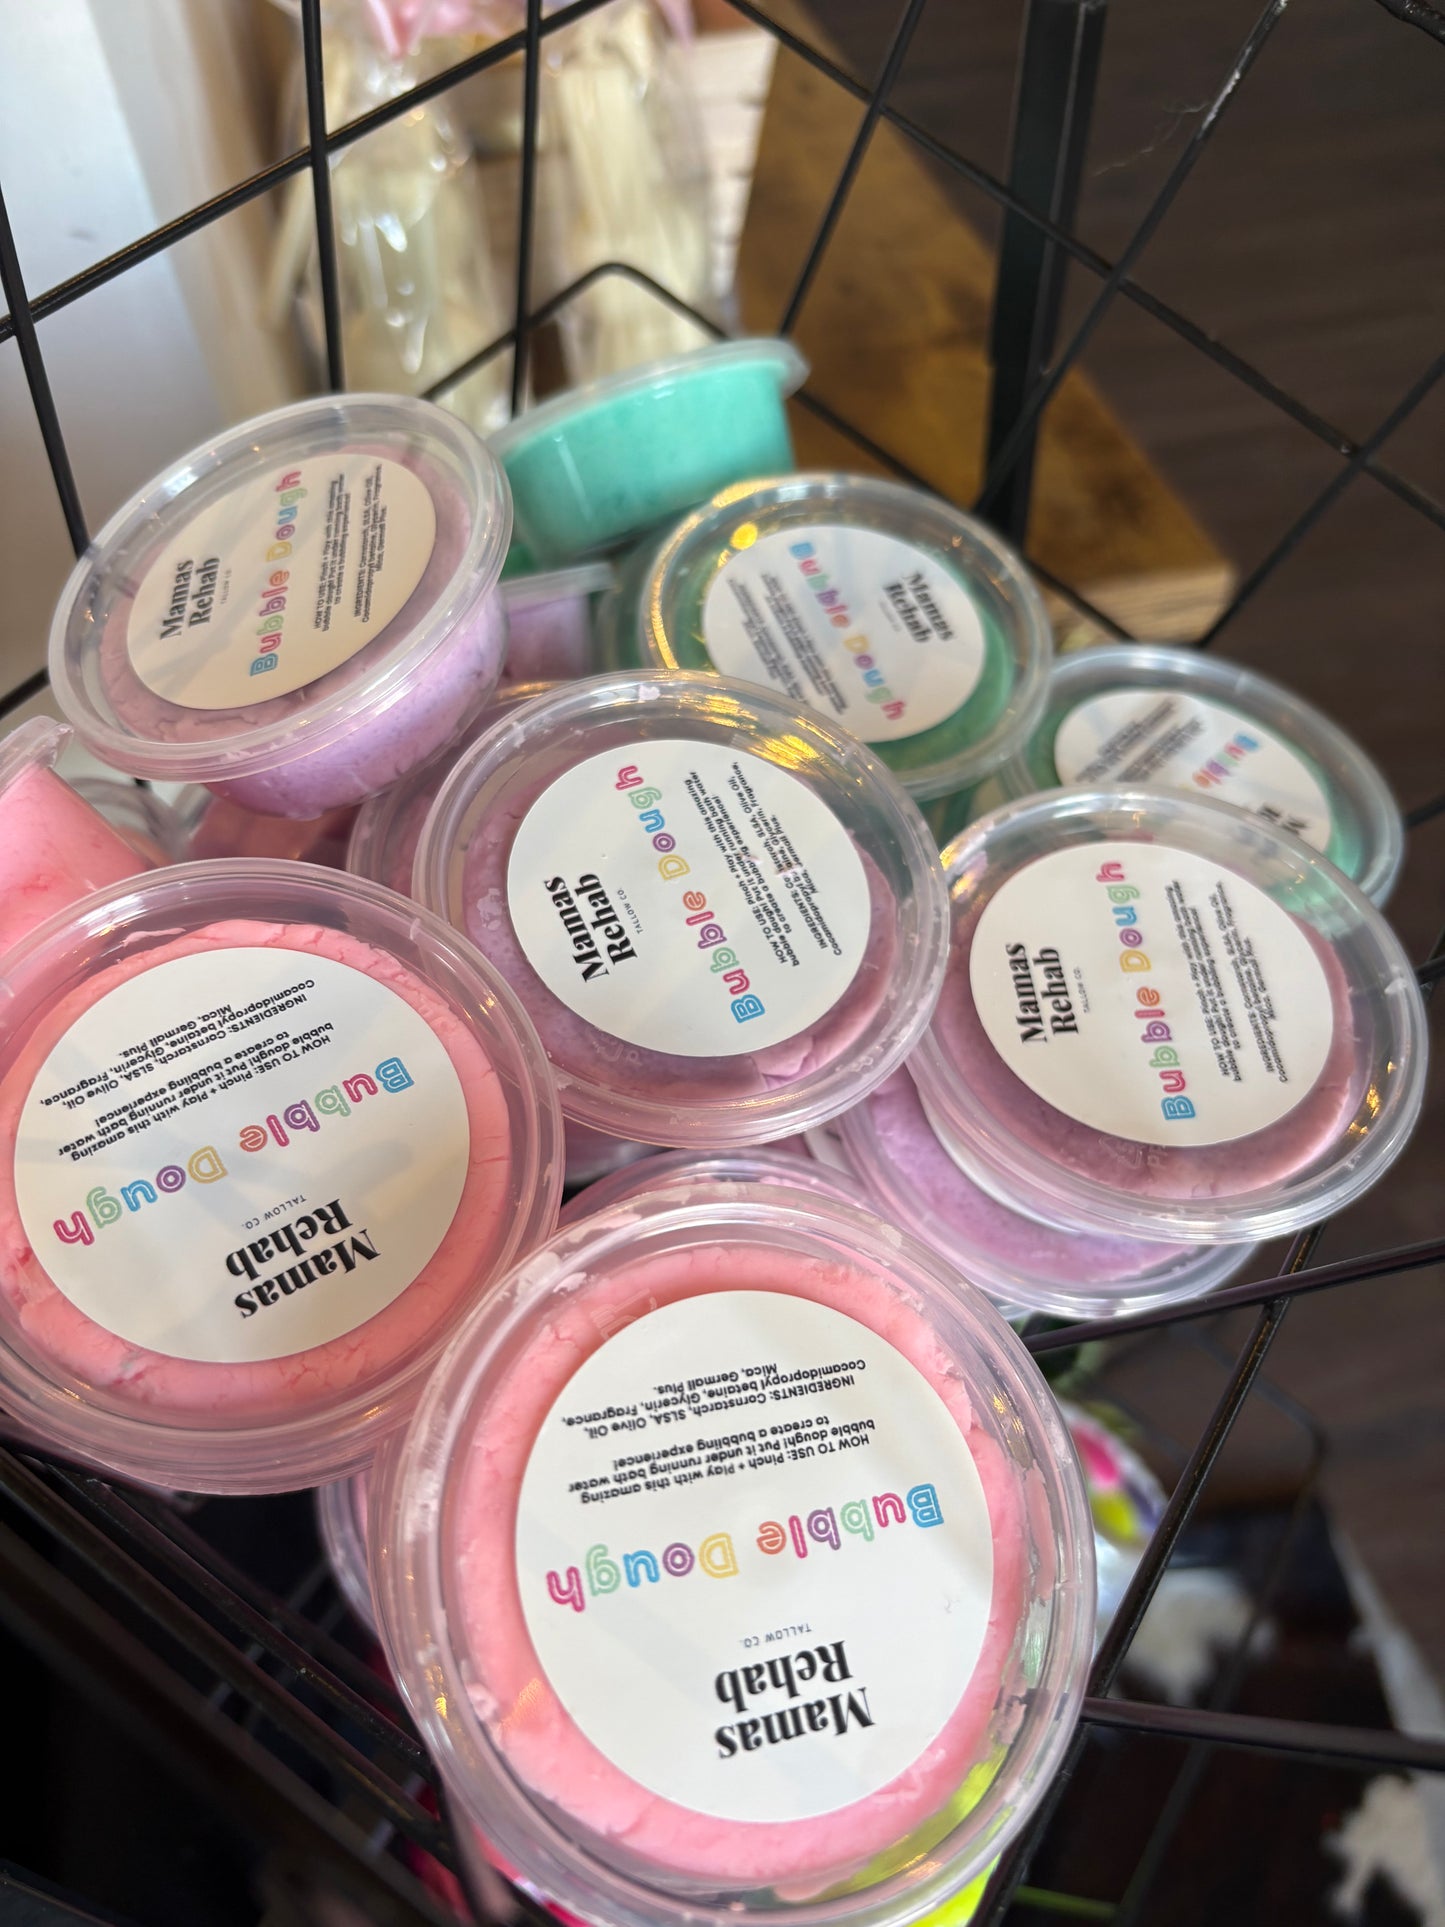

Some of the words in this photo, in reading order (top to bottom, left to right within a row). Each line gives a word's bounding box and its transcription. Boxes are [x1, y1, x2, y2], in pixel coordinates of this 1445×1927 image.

[265, 470, 309, 565] Dough
[159, 560, 194, 642] Mamas
[188, 557, 220, 629] Rehab
[250, 569, 290, 677] Bubble
[689, 771, 706, 796] water
[727, 775, 740, 791] Oil,
[731, 762, 759, 808] Fragrance,
[684, 778, 708, 815] amazing
[703, 796, 719, 818] bath
[736, 791, 752, 814] Olive
[614, 764, 691, 883] Dough
[704, 815, 717, 833] this
[711, 795, 744, 845] experience!
[749, 813, 766, 838] SLSA,
[756, 807, 780, 846] Glycerin,
[770, 814, 784, 835] Plus.
[713, 833, 728, 853] with
[715, 817, 737, 851] running
[724, 854, 739, 873] Play
[733, 852, 751, 877] under
[738, 880, 756, 906] Pinch
[751, 885, 764, 902] Put
[801, 869, 818, 895] Mica,
[573, 873, 638, 965] Rehab
[623, 902, 644, 935] TALLOW
[752, 905, 767, 926] USE:
[759, 902, 782, 934] dough!
[765, 892, 786, 923] create
[1095, 862, 1152, 974] Dough
[543, 876, 610, 983] Mamas
[791, 889, 828, 950] INGREDIENTS:
[795, 882, 842, 957] Cocamidopropyl
[762, 926, 774, 940] TO
[681, 890, 766, 1024] Bubble
[769, 940, 788, 964] HOW
[778, 934, 800, 968] bubble
[216, 977, 315, 1028] Cocamidopropyl
[1004, 943, 1048, 1044] Mamas
[1032, 947, 1079, 1035] Rehab
[197, 1003, 232, 1022] Mica,
[227, 991, 307, 1032] INGREDIENTS:
[148, 1019, 197, 1047] Germall
[164, 1021, 217, 1048] betaine,
[275, 1030, 290, 1040] to
[291, 1021, 334, 1045] bubble
[300, 1033, 331, 1054] HOW
[118, 1041, 149, 1058] Plus.
[154, 1029, 226, 1065] Cornstarch,
[233, 1037, 274, 1060] create
[247, 1041, 290, 1067] dough!
[281, 1049, 300, 1062] TO
[1133, 986, 1196, 1121] Bubble
[109, 1046, 165, 1074] Glycerin,
[119, 1062, 155, 1081] SLSA,
[225, 1061, 248, 1076] Put
[253, 1057, 281, 1074] USE:
[167, 1061, 224, 1091] bubbling
[214, 1071, 226, 1082] it
[218, 1070, 254, 1091] Pinch
[39, 1071, 109, 1105] Fragrance,
[85, 1079, 119, 1098] Olive
[178, 1077, 214, 1099] under
[61, 1094, 85, 1109] Oil,
[94, 1087, 167, 1128] experience!
[128, 1094, 177, 1122] running
[182, 1091, 209, 1109] Play
[239, 1055, 415, 1154] Bubble
[152, 1105, 181, 1122] with
[96, 1117, 129, 1136] bath
[126, 1118, 151, 1134] this
[57, 1133, 96, 1155] water
[69, 1130, 125, 1161] amazing
[51, 1145, 231, 1245] Dough
[263, 1194, 308, 1221] TALLOW
[224, 1198, 353, 1281] Rehab
[233, 1228, 381, 1319] Mamas
[686, 1371, 739, 1391] Germall
[740, 1363, 778, 1378] Mica,
[760, 1359, 866, 1391] Cocamidopropyl
[653, 1381, 685, 1395] Plus.
[702, 1380, 759, 1399] betaine,
[768, 1374, 855, 1401] INGREDIENTS:
[640, 1391, 701, 1413] Glycerin,
[687, 1392, 767, 1417] Cornstarch,
[561, 1404, 638, 1427] Fragrance,
[610, 1416, 647, 1432] Olive
[649, 1408, 687, 1425] SLSA,
[769, 1418, 813, 1436] create
[815, 1415, 830, 1426] to
[583, 1424, 609, 1440] Oil,
[757, 1428, 768, 1438] a
[782, 1429, 828, 1449] dough!
[830, 1418, 876, 1437] bubble
[696, 1430, 757, 1451] bubbling
[745, 1444, 757, 1456] it
[757, 1439, 781, 1453] Put
[817, 1441, 836, 1455] TO
[838, 1433, 870, 1451] HOW
[612, 1443, 694, 1471] experience!
[704, 1447, 743, 1464] under
[747, 1452, 785, 1470] Pinch
[786, 1445, 816, 1461] USE:
[612, 1467, 647, 1484] bath
[648, 1456, 703, 1475] running
[706, 1463, 736, 1477] Play
[568, 1476, 611, 1493] water
[644, 1477, 671, 1492] this
[673, 1470, 704, 1486] with
[580, 1483, 642, 1504] amazing
[755, 1482, 945, 1560] Bubble
[544, 1531, 741, 1614] Dough
[764, 1622, 813, 1643] TALLOW
[714, 1640, 853, 1714] Rehab
[714, 1686, 875, 1759] Mamas
